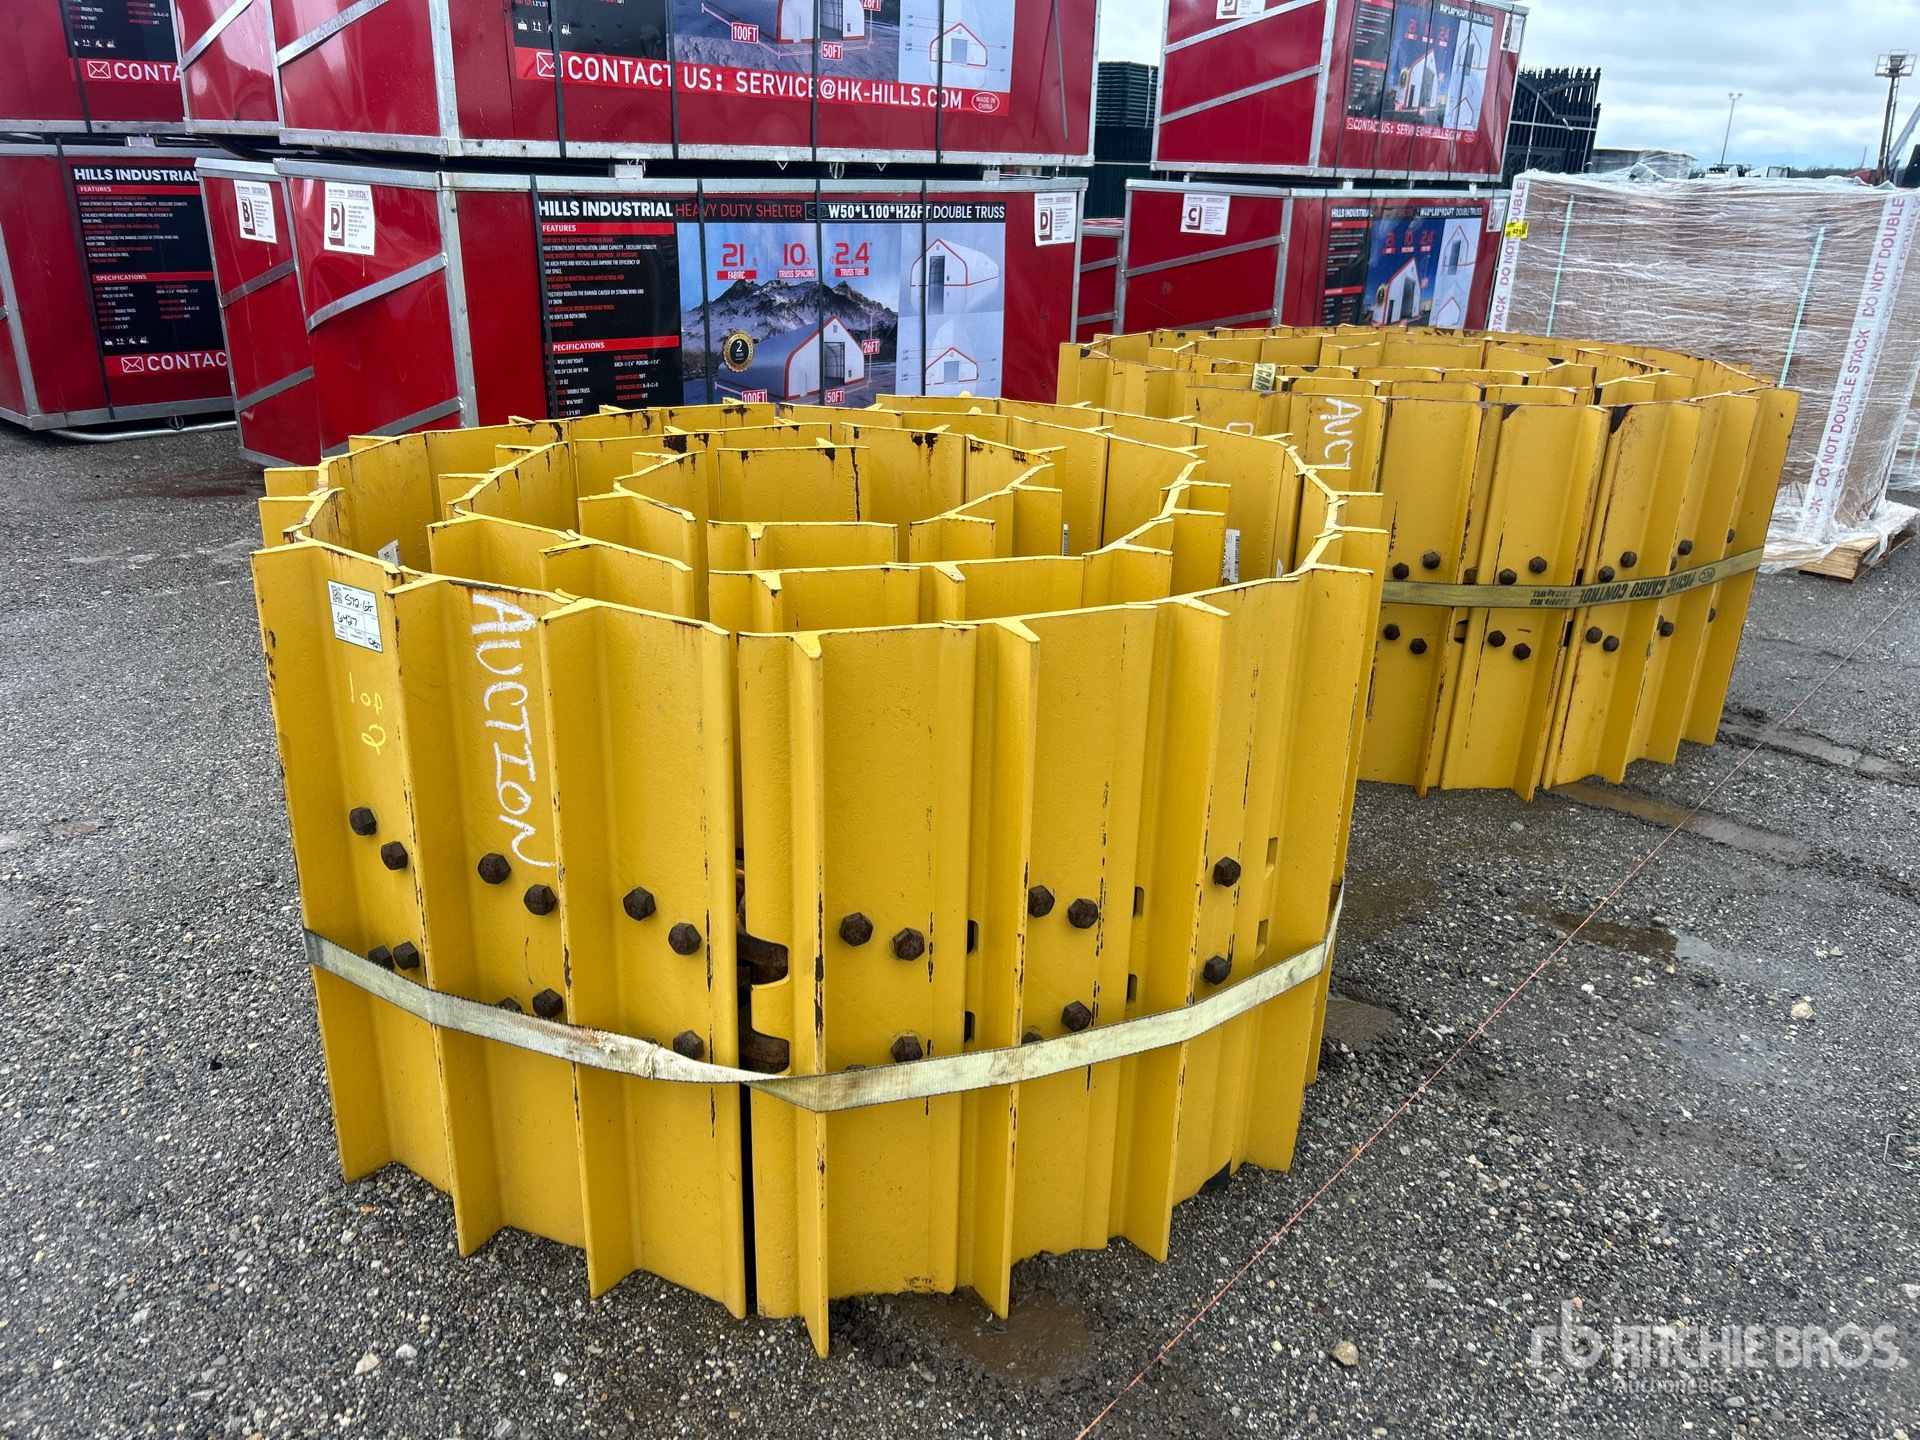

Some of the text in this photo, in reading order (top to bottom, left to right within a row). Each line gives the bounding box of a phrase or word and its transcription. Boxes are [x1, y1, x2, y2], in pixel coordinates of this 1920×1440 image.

[732, 25, 758, 42] 100FT
[822, 44, 842, 59] 50FT
[567, 56, 672, 88] CONTACT
[684, 67, 722, 92] US:
[74, 168, 200, 181] HILLS INDUSTRIAL
[242, 202, 250, 222] B
[539, 201, 579, 216] HILLS
[583, 201, 673, 217] INDUSTRIAL
[676, 203, 716, 217] HEAVY
[720, 204, 751, 217] DUTY
[756, 204, 802, 218] SHELTER
[934, 206, 972, 218] DOUBLE
[975, 206, 1005, 218] TRUSS
[1188, 208, 1197, 221] C
[1332, 208, 1344, 217] HILLS
[331, 207, 340, 231] D
[1040, 212, 1048, 230] D
[722, 243, 744, 267] 21
[784, 243, 806, 266] 10
[1862, 198, 1905, 317] DO NOT DOUBLE
[794, 269, 815, 277] SPACING
[1500, 267, 1511, 285] DO
[553, 342, 605, 351] PECIFICATIONS
[736, 340, 743, 352] 2
[863, 341, 880, 353] 26FT
[147, 352, 227, 371] CONTAC
[743, 392, 766, 403] 100FT
[826, 391, 844, 404] 50FT
[1816, 329, 1870, 487] DO NOT DOUBLE STACK
[1578, 584, 1628, 604] CONTROL
[1629, 580, 1666, 598] CARGO
[337, 612, 358, 627] 6427
[471, 594, 556, 866] AUCTION
